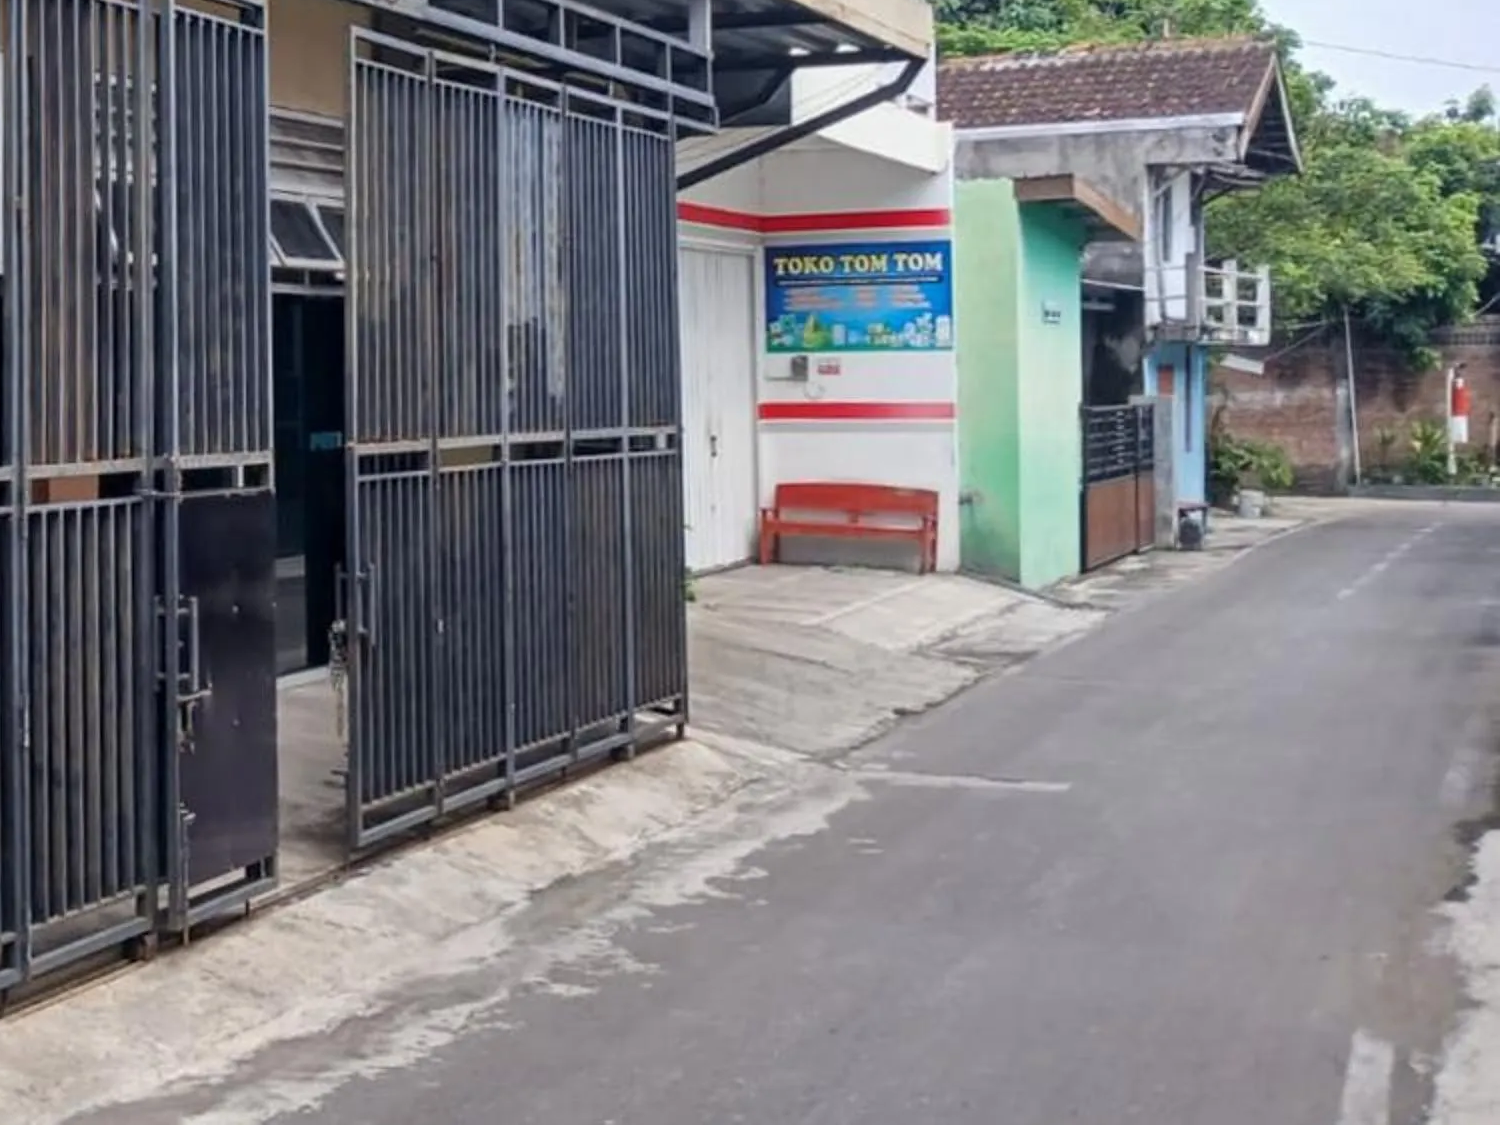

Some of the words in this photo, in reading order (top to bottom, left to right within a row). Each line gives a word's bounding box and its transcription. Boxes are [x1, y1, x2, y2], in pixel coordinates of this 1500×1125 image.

[773, 255, 835, 275] TOKO
[840, 254, 889, 273] TOM
[894, 251, 943, 271] TOM
